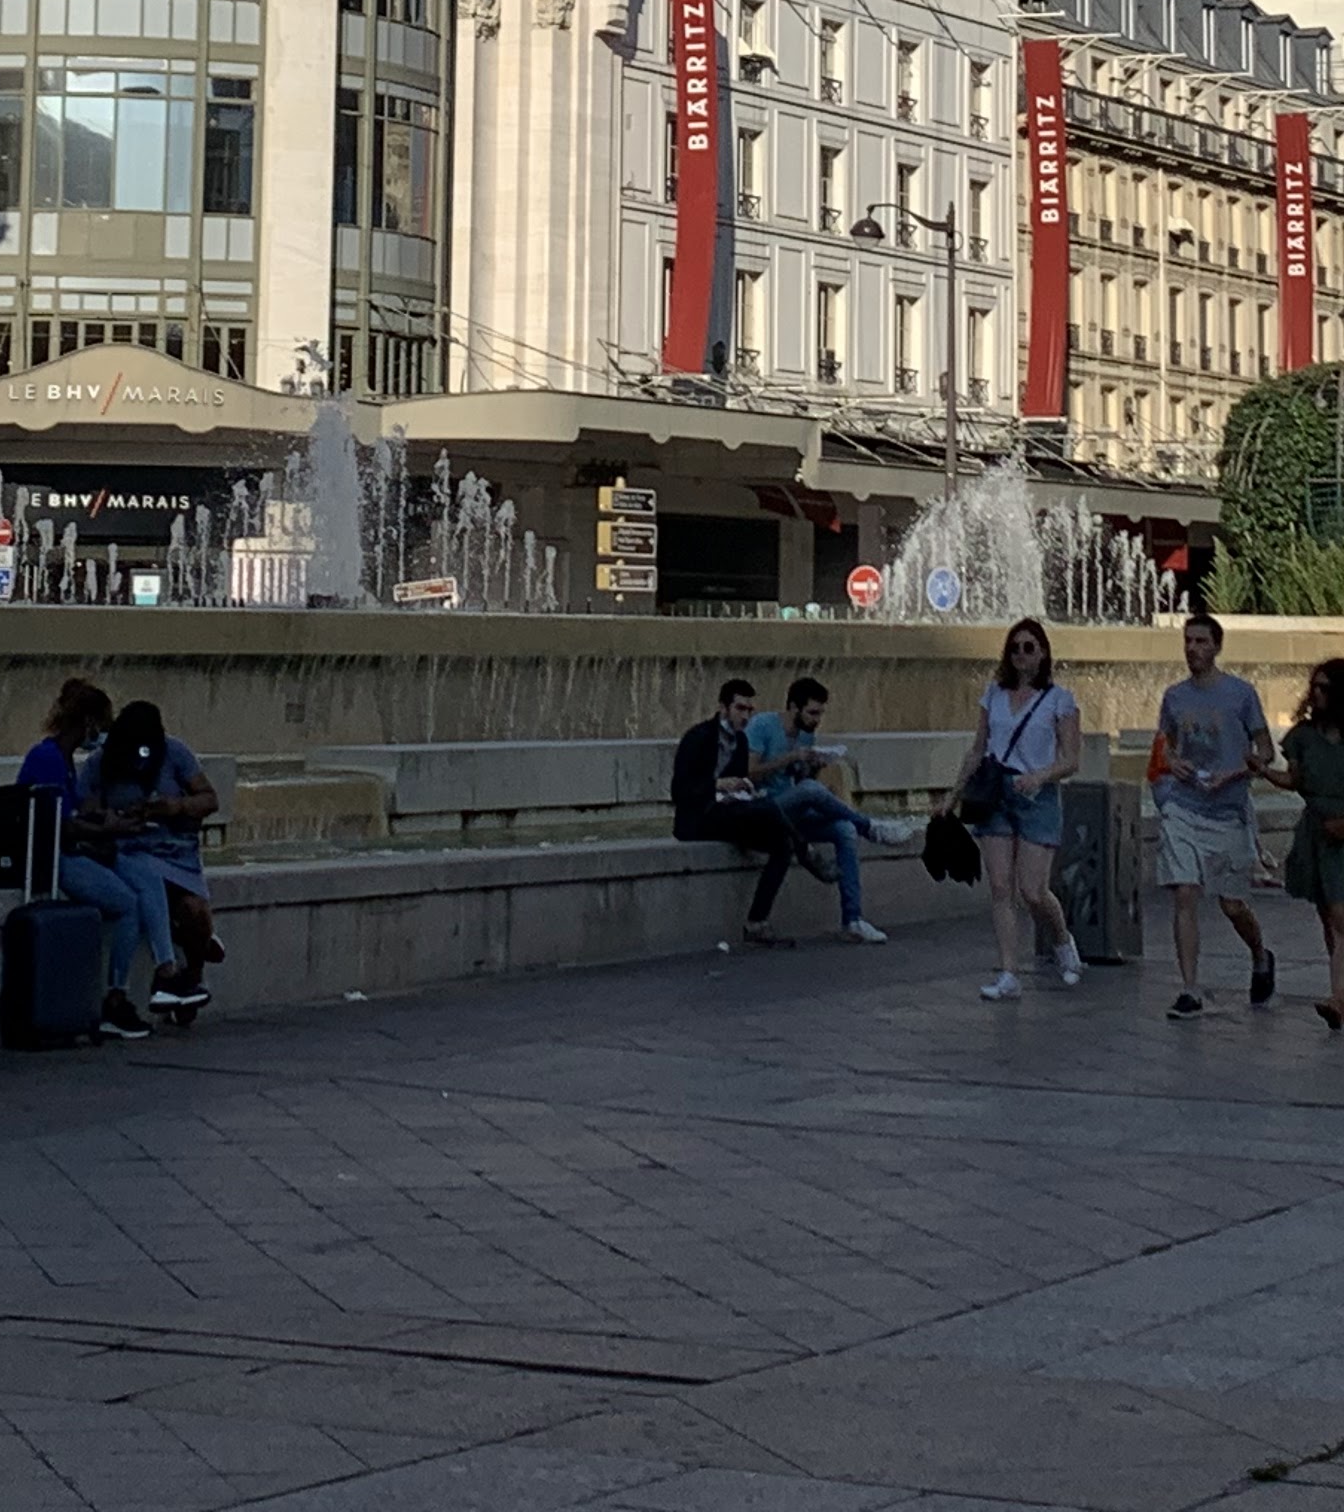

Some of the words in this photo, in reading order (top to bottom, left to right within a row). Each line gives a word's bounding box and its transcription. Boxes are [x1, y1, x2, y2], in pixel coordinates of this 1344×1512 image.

[682, 1, 709, 151] BIARRITZ
[1035, 94, 1060, 224] BIARRITZ
[1284, 161, 1307, 277] BIARRITZ
[8, 383, 37, 401] LE
[47, 384, 101, 401] BHV
[122, 385, 226, 407] MARAIS
[48, 492, 93, 508] BHV
[106, 494, 191, 510] MARAIS
